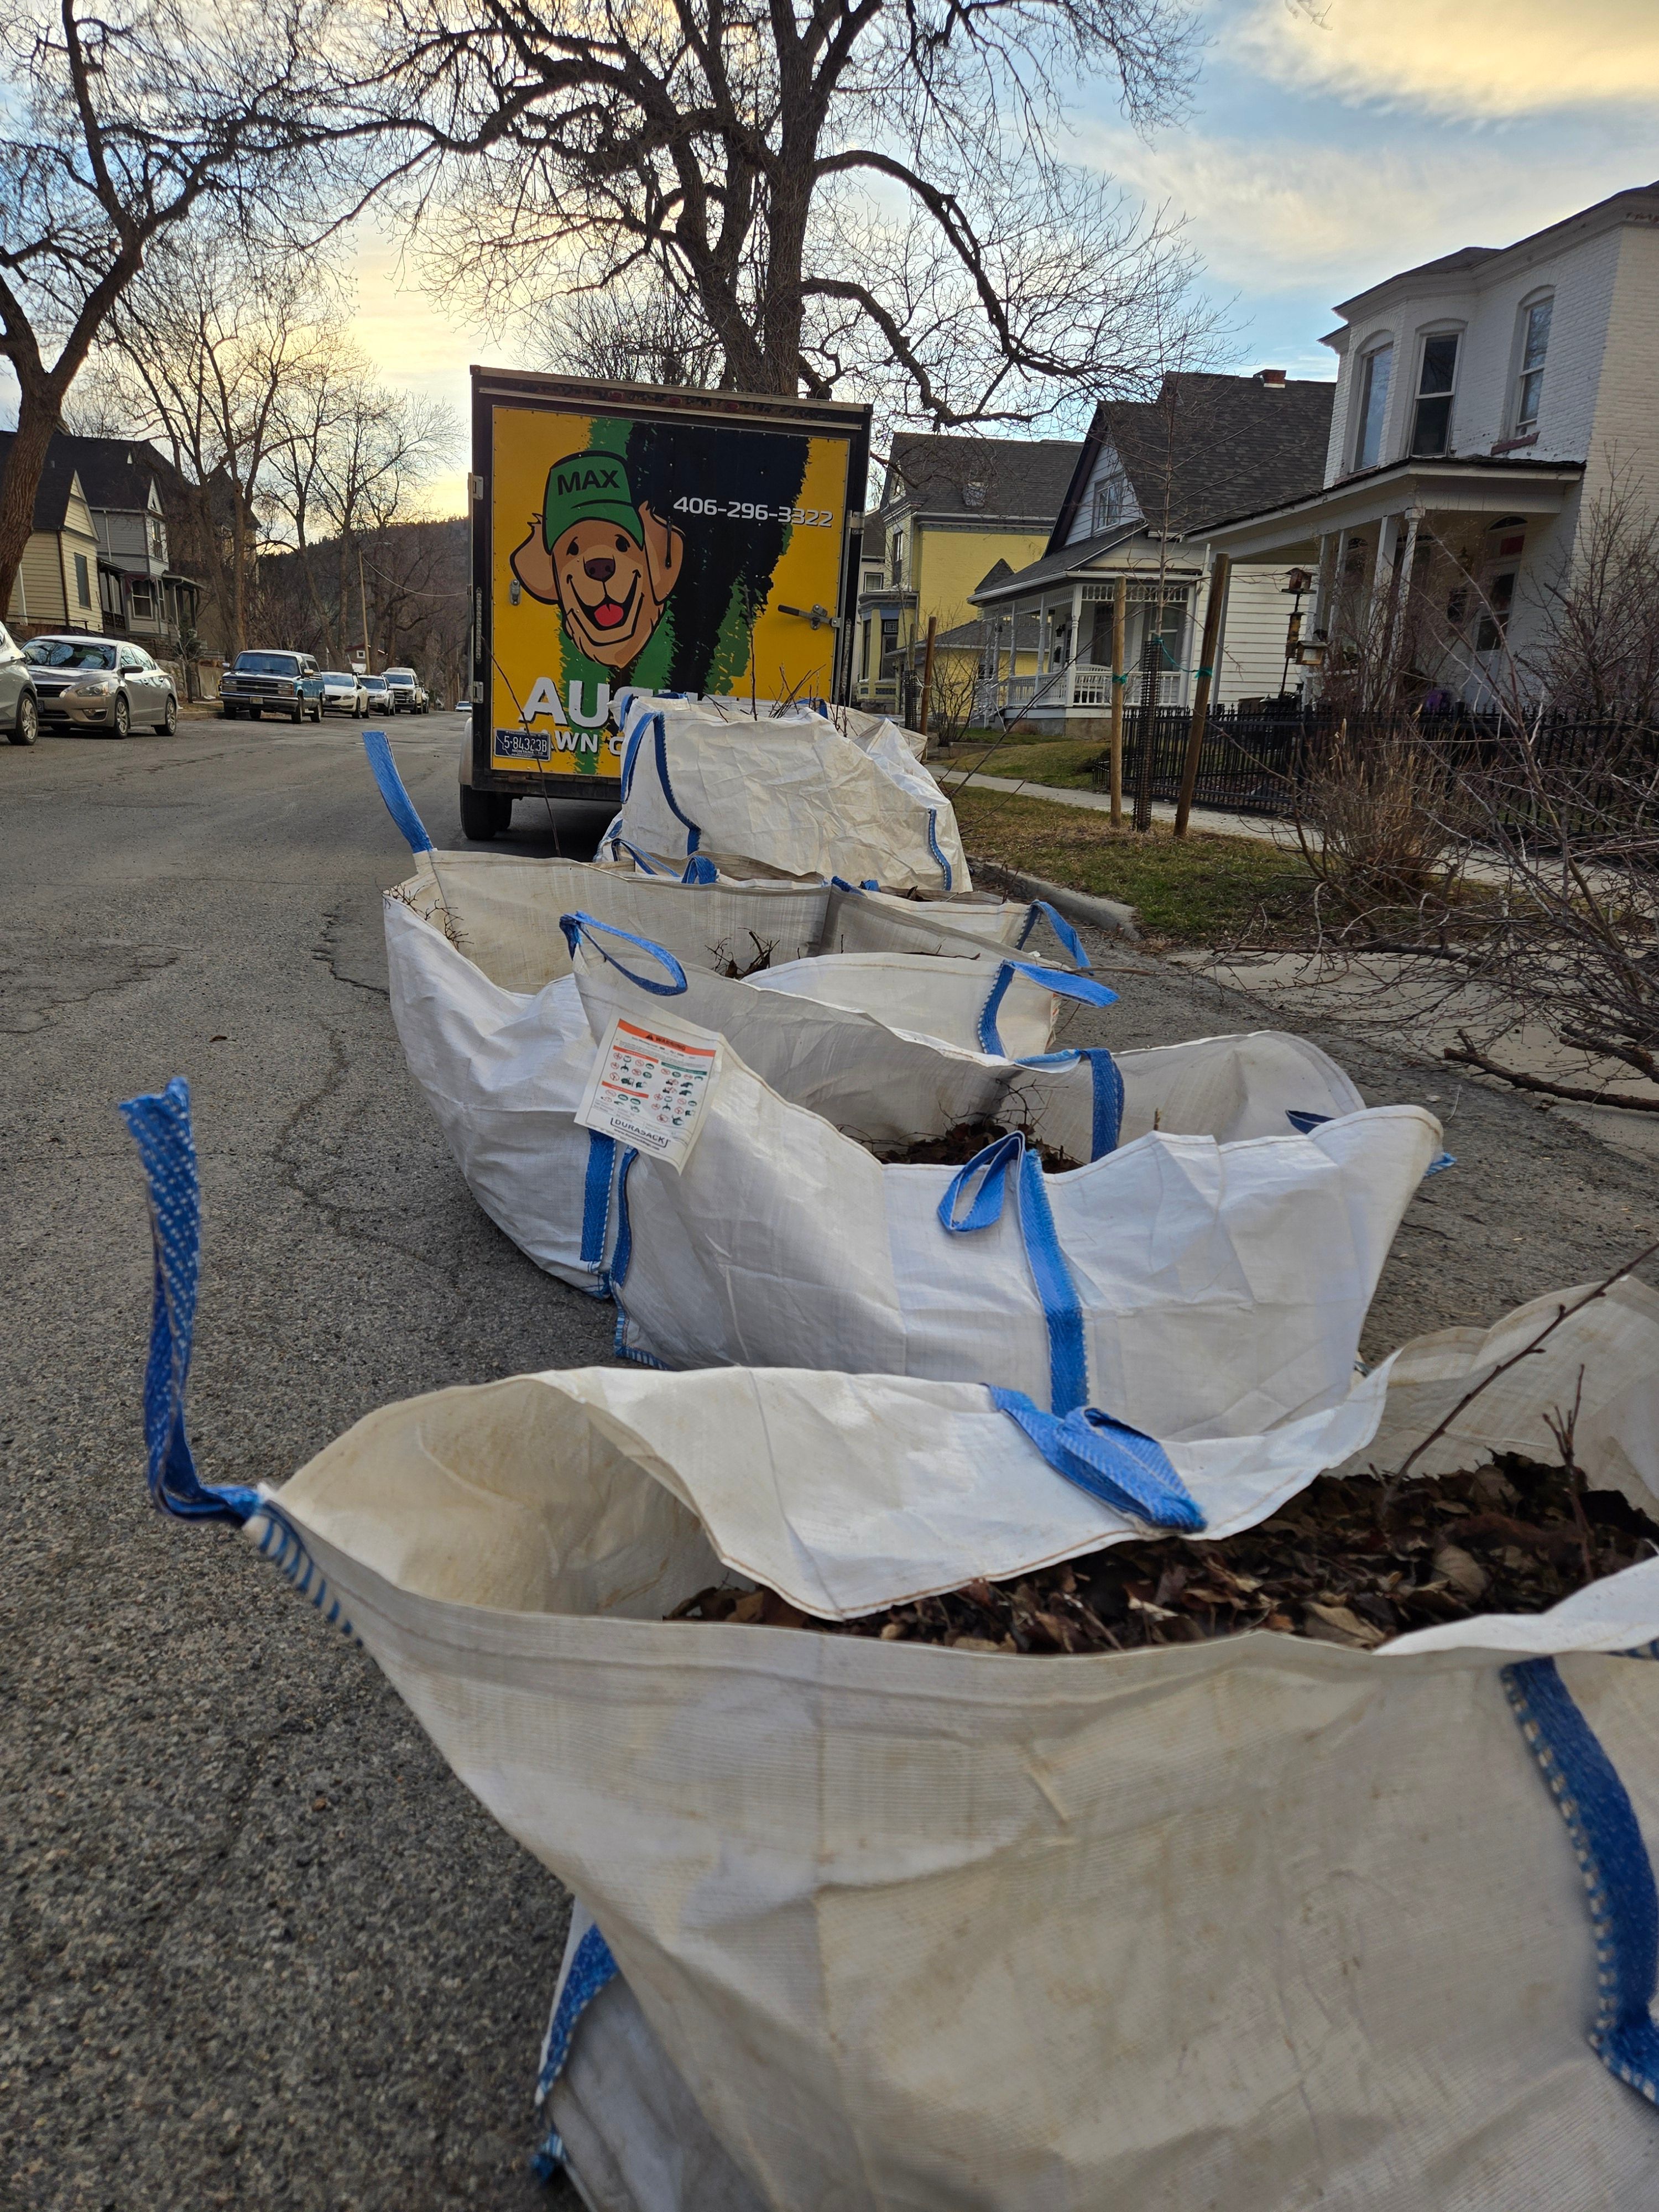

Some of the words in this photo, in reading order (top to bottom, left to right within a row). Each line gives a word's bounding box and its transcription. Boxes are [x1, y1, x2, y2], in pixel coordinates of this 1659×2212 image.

[557, 469, 620, 495] MAX
[673, 497, 833, 527] 406-296-3322
[655, 1036, 686, 1051] WARNING
[615, 1119, 665, 1144] DURASACK
